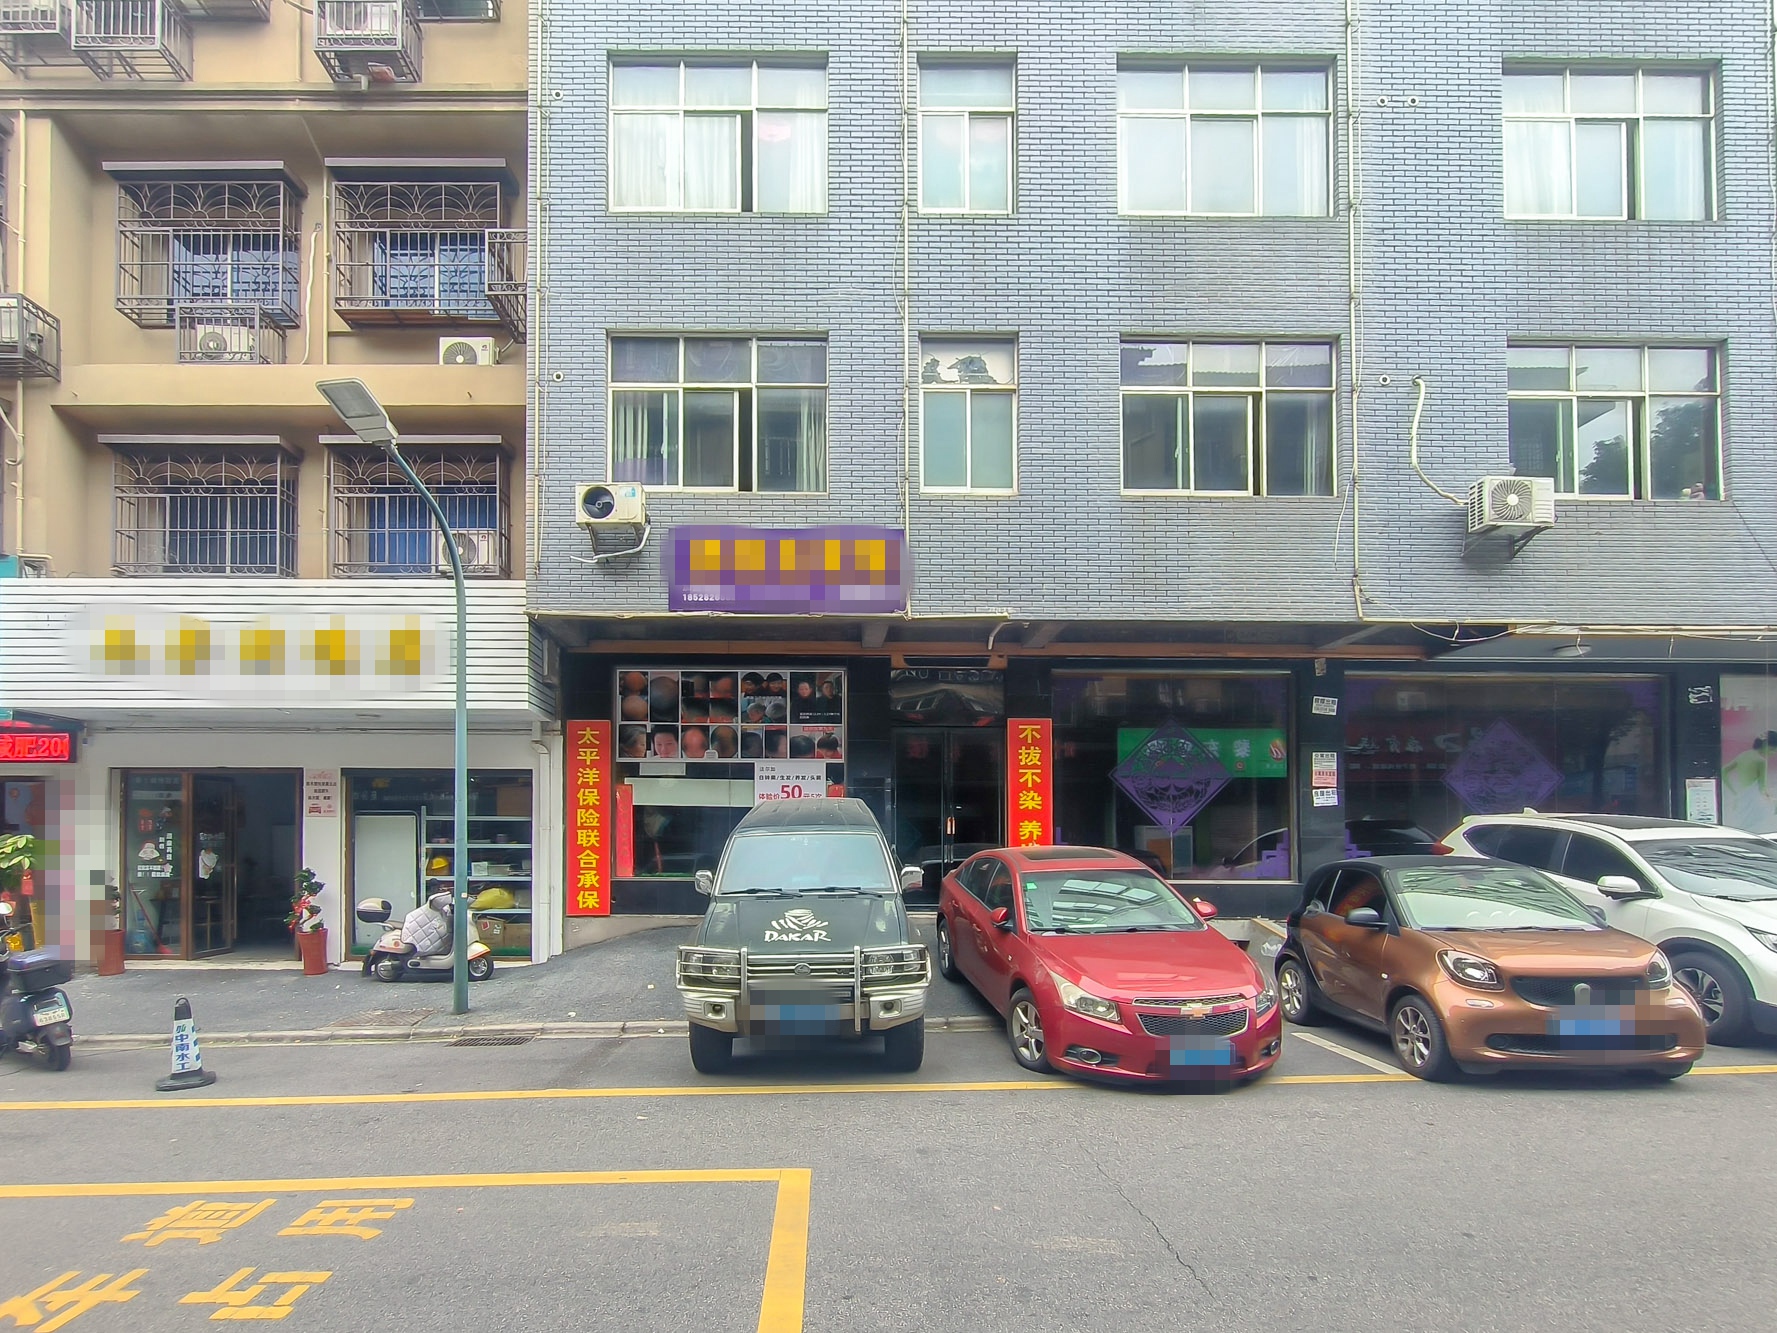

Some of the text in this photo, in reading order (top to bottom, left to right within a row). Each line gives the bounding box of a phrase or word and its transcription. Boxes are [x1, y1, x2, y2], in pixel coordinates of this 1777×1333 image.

[576, 726, 601, 909] 太平洋保险联合承保
[1018, 724, 1042, 848] 不拔不染 养
[764, 929, 832, 943] DAKAR
